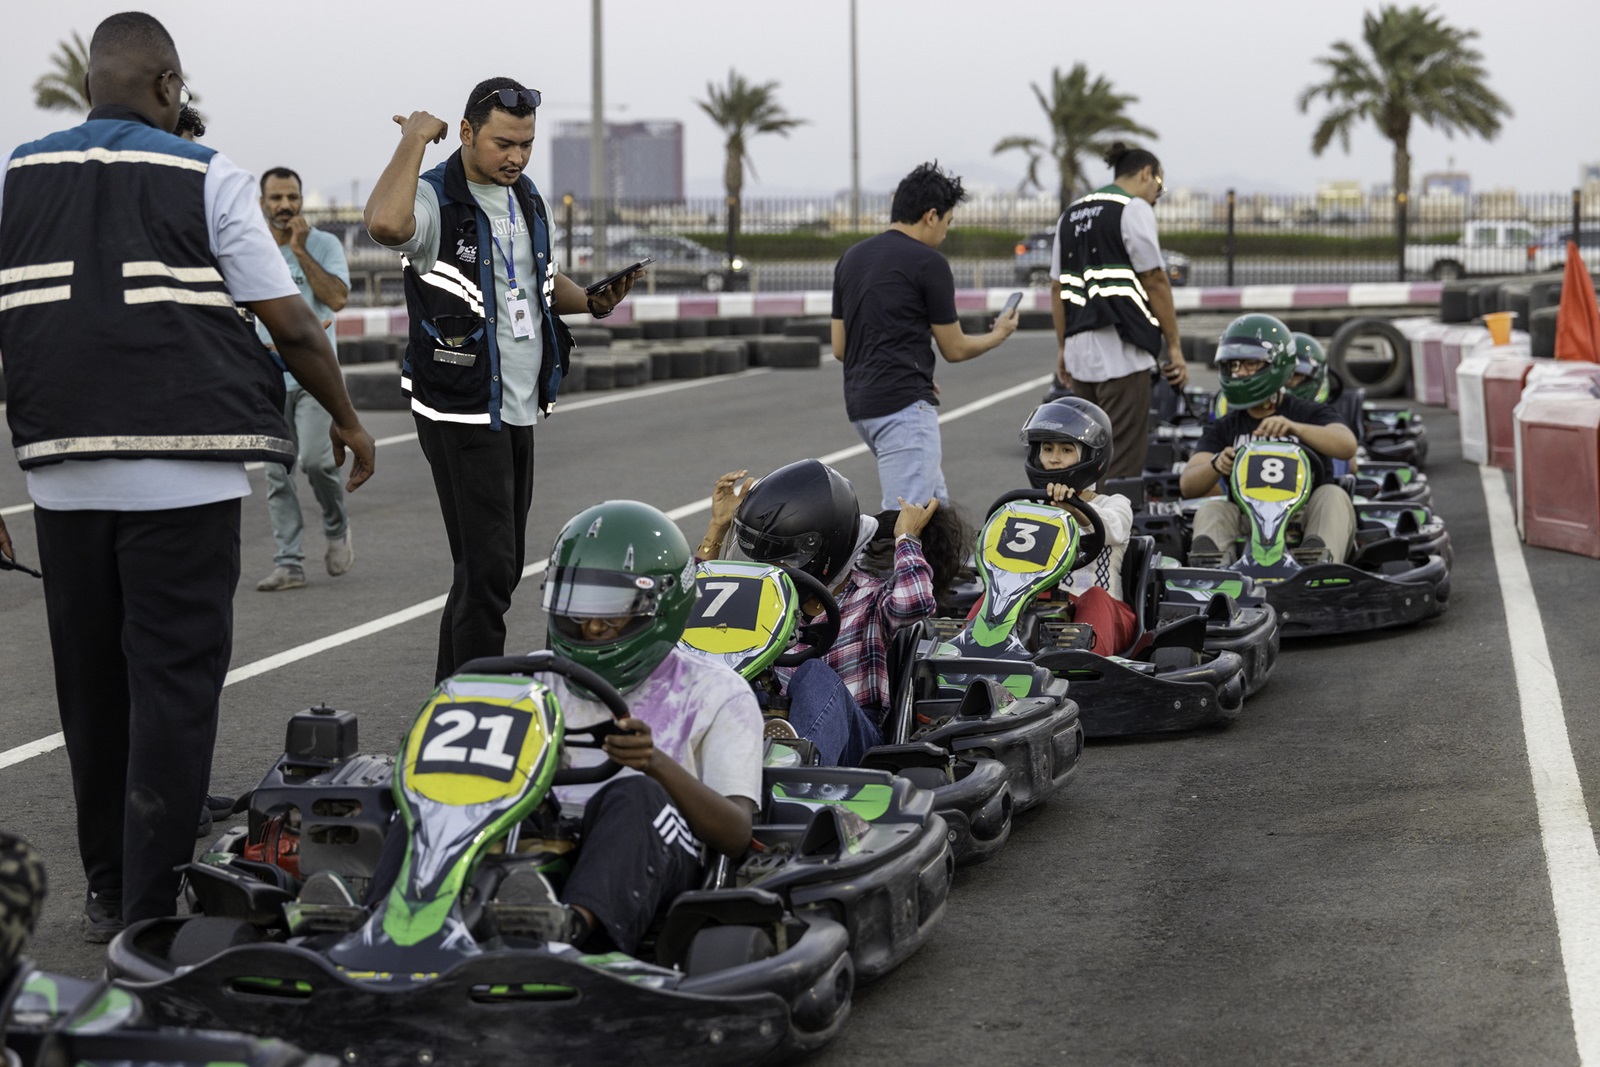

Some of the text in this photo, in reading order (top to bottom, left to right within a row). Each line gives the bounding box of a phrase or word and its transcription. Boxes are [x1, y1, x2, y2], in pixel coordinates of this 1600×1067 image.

[1260, 458, 1284, 483] 8
[1006, 522, 1040, 553] 3
[701, 582, 739, 617] 7
[422, 709, 515, 771] 21
